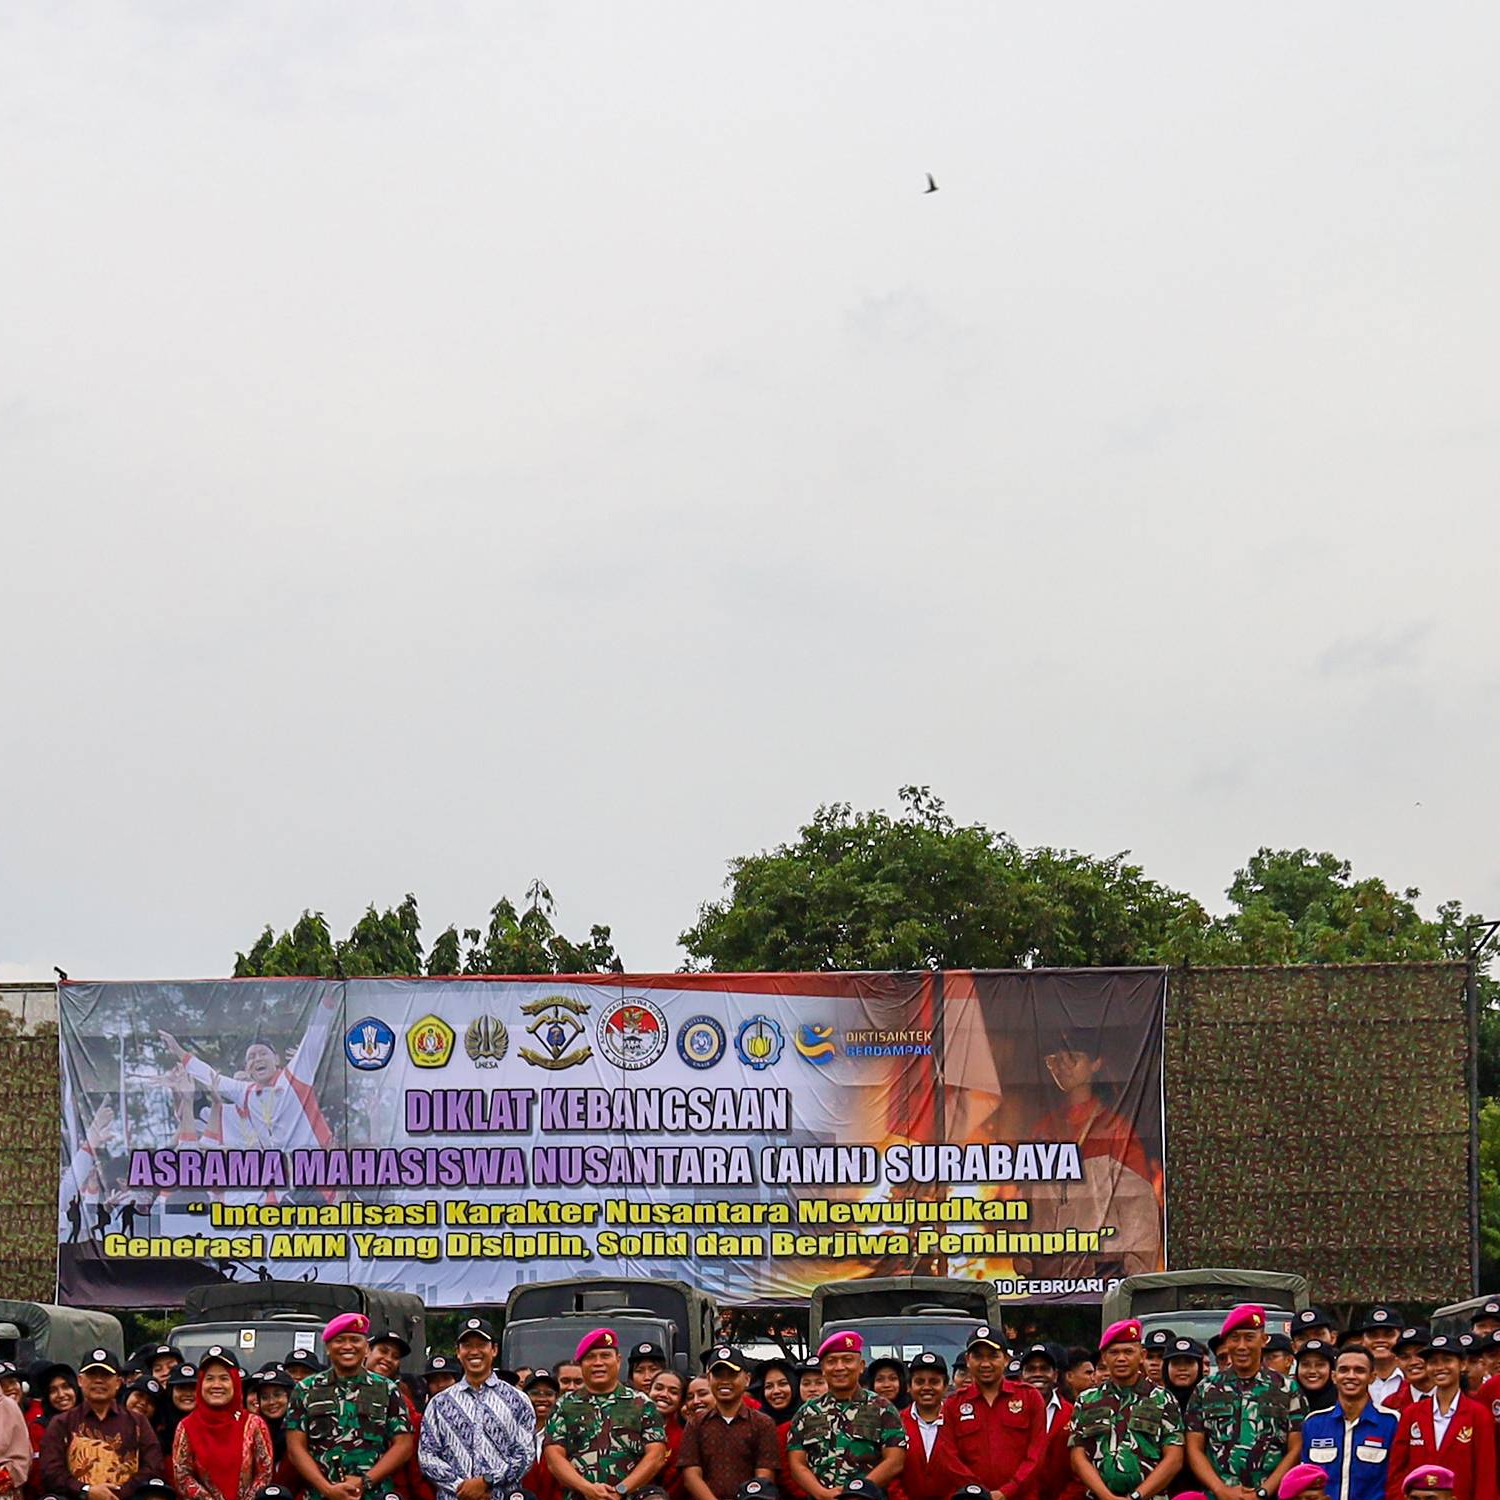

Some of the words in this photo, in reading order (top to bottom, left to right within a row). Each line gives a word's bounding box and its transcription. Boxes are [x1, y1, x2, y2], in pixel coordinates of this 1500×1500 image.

[846, 1030, 933, 1042] DIKTISAINTEK
[846, 1044, 933, 1057] BERDAMPAK
[407, 1089, 534, 1132] DIKLAT
[542, 1088, 788, 1131] KEBANGSAAN
[128, 1148, 286, 1187] ASRAMA
[293, 1147, 525, 1186] MAHASISWA
[533, 1147, 757, 1184] NUSANTARA
[761, 1145, 876, 1184] (AMN)
[885, 1143, 1082, 1183] SURABAYA
[445, 1201, 600, 1226] Karakter
[605, 1199, 789, 1225] Nusantara
[798, 1198, 1029, 1226] Mewujudkan
[103, 1233, 263, 1258] Generasi
[269, 1234, 346, 1258] AMN
[354, 1233, 439, 1261] Yang
[444, 1232, 591, 1260] Disiplin,
[597, 1231, 689, 1257] Solid
[695, 1231, 765, 1257] dan
[771, 1230, 911, 1258] Berjiwa
[995, 1279, 1013, 1294] 10
[1017, 1278, 1104, 1295] FEBRUARI
